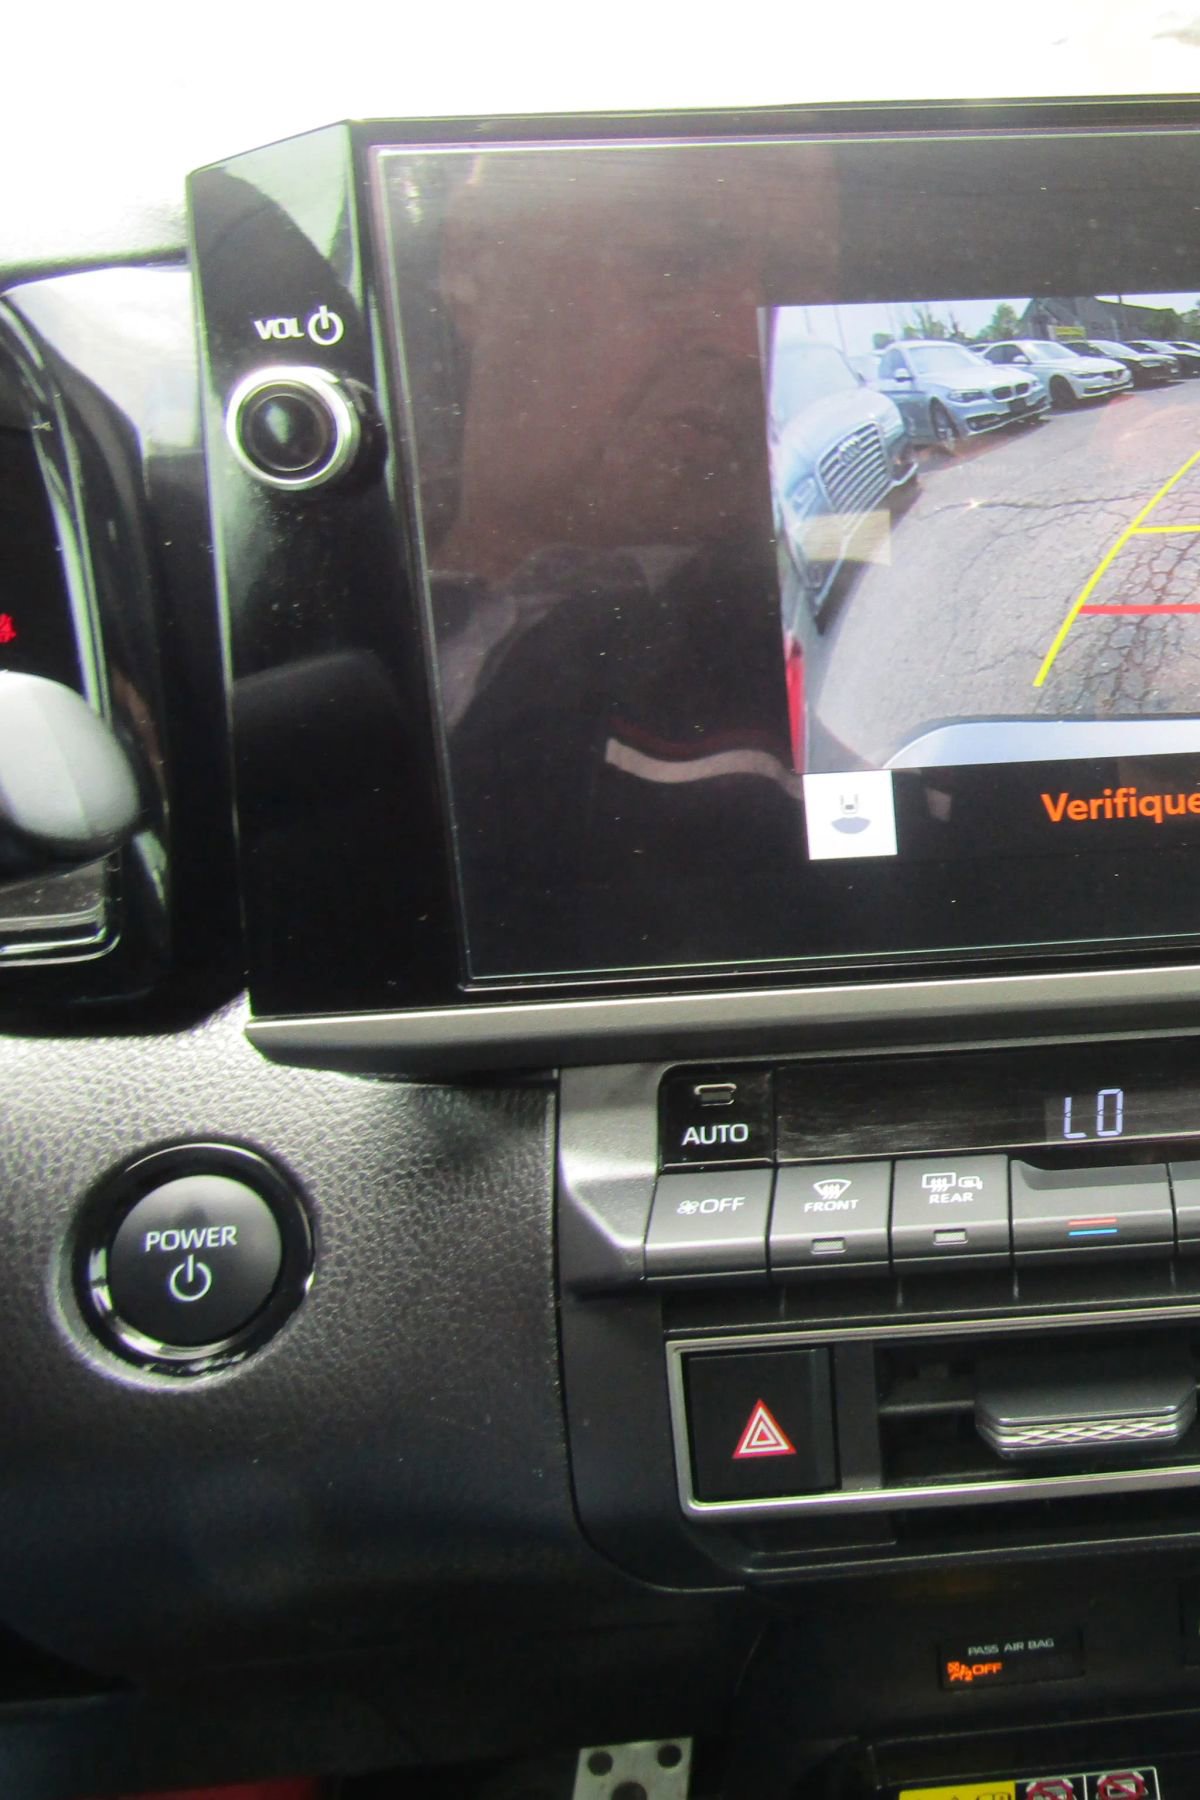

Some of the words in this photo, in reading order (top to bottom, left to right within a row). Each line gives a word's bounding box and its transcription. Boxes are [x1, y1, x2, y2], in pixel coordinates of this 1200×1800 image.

[254, 317, 305, 340] VOL
[681, 1122, 750, 1146] AUTO
[700, 1195, 746, 1214] OFF
[804, 1198, 860, 1212] FRONT
[929, 1190, 974, 1204] REAR
[145, 1225, 239, 1252] POWER
[967, 1645, 999, 1656] PASS
[1004, 1641, 1025, 1652] AIR
[1028, 1638, 1054, 1650] BAG
